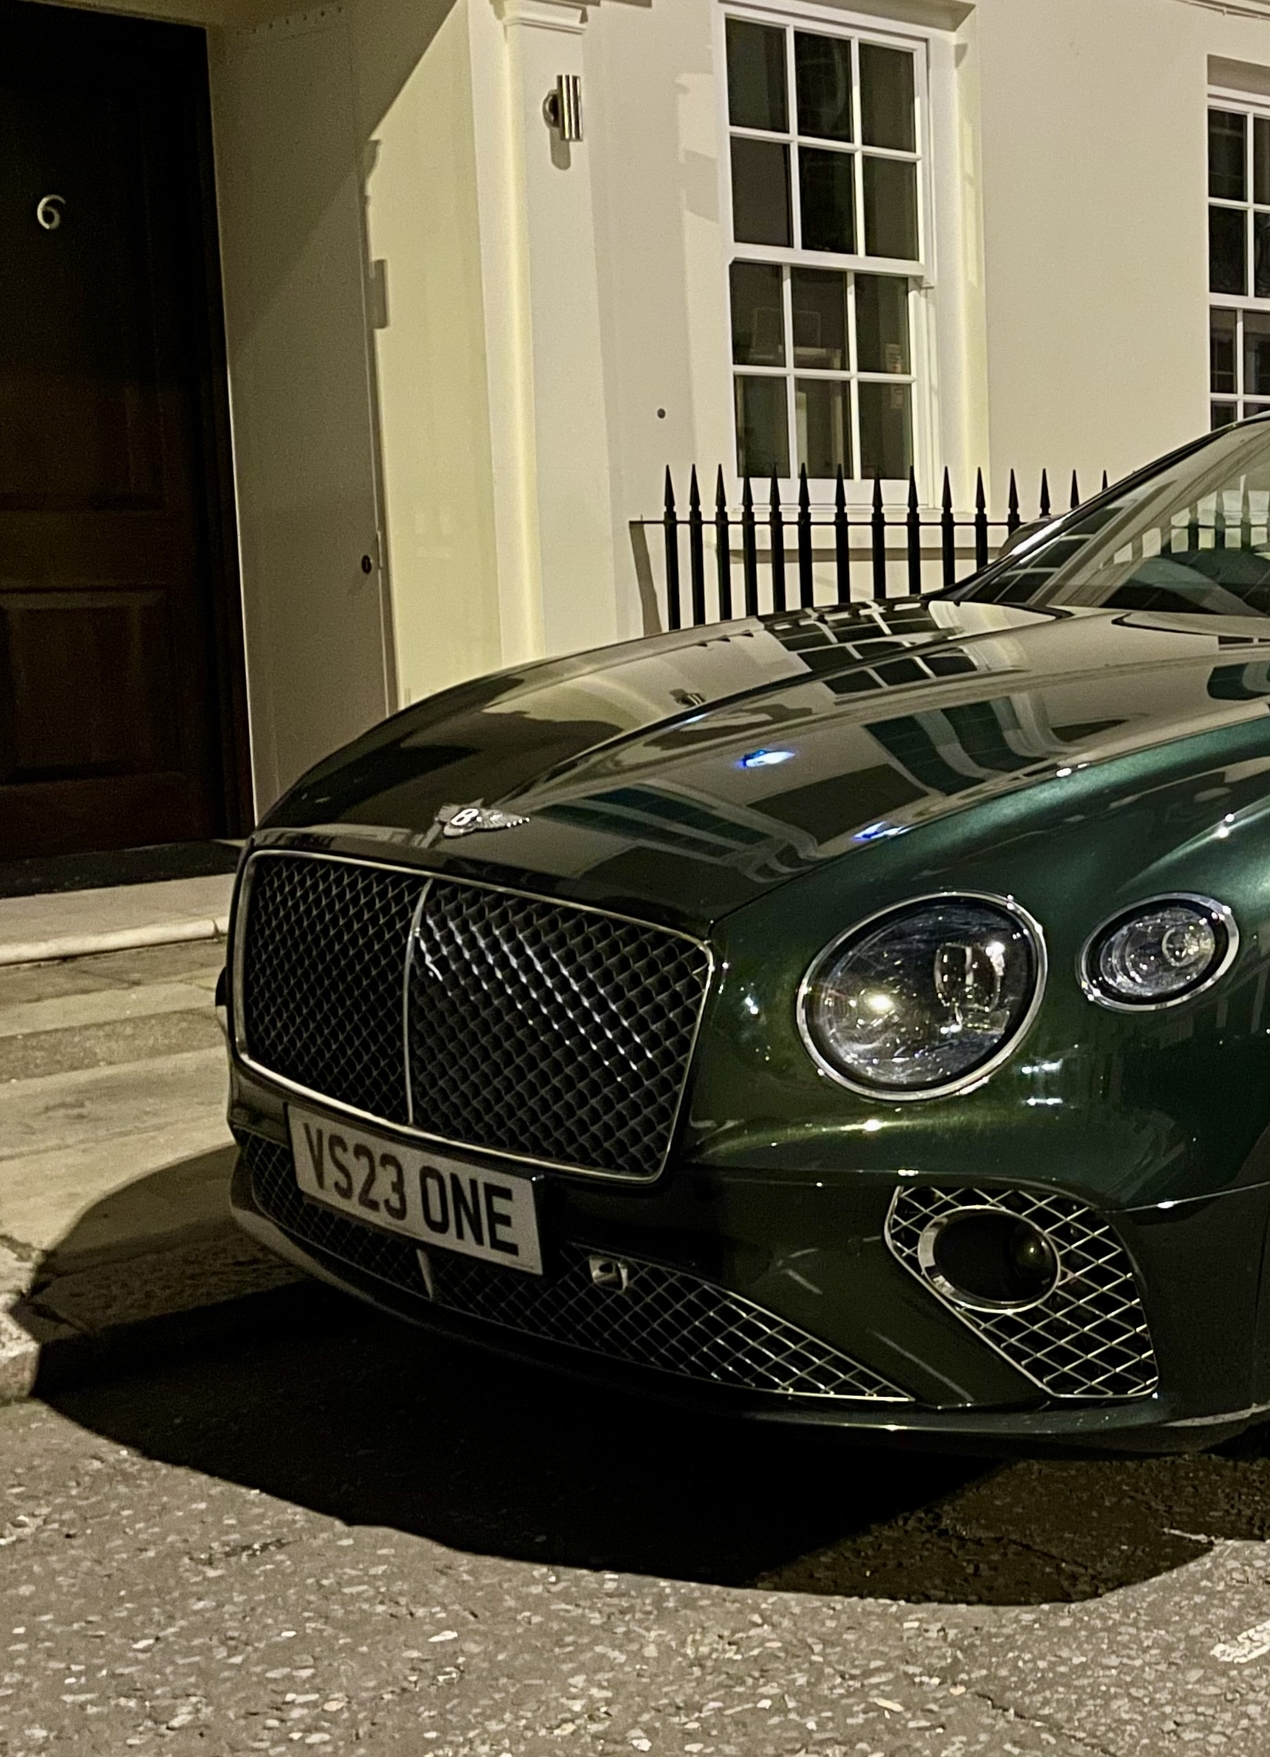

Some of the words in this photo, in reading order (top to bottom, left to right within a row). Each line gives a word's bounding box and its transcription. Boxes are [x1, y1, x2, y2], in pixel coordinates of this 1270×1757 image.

[37, 194, 66, 229] 6
[303, 1122, 407, 1222] VS23
[419, 1164, 519, 1257] ONE
